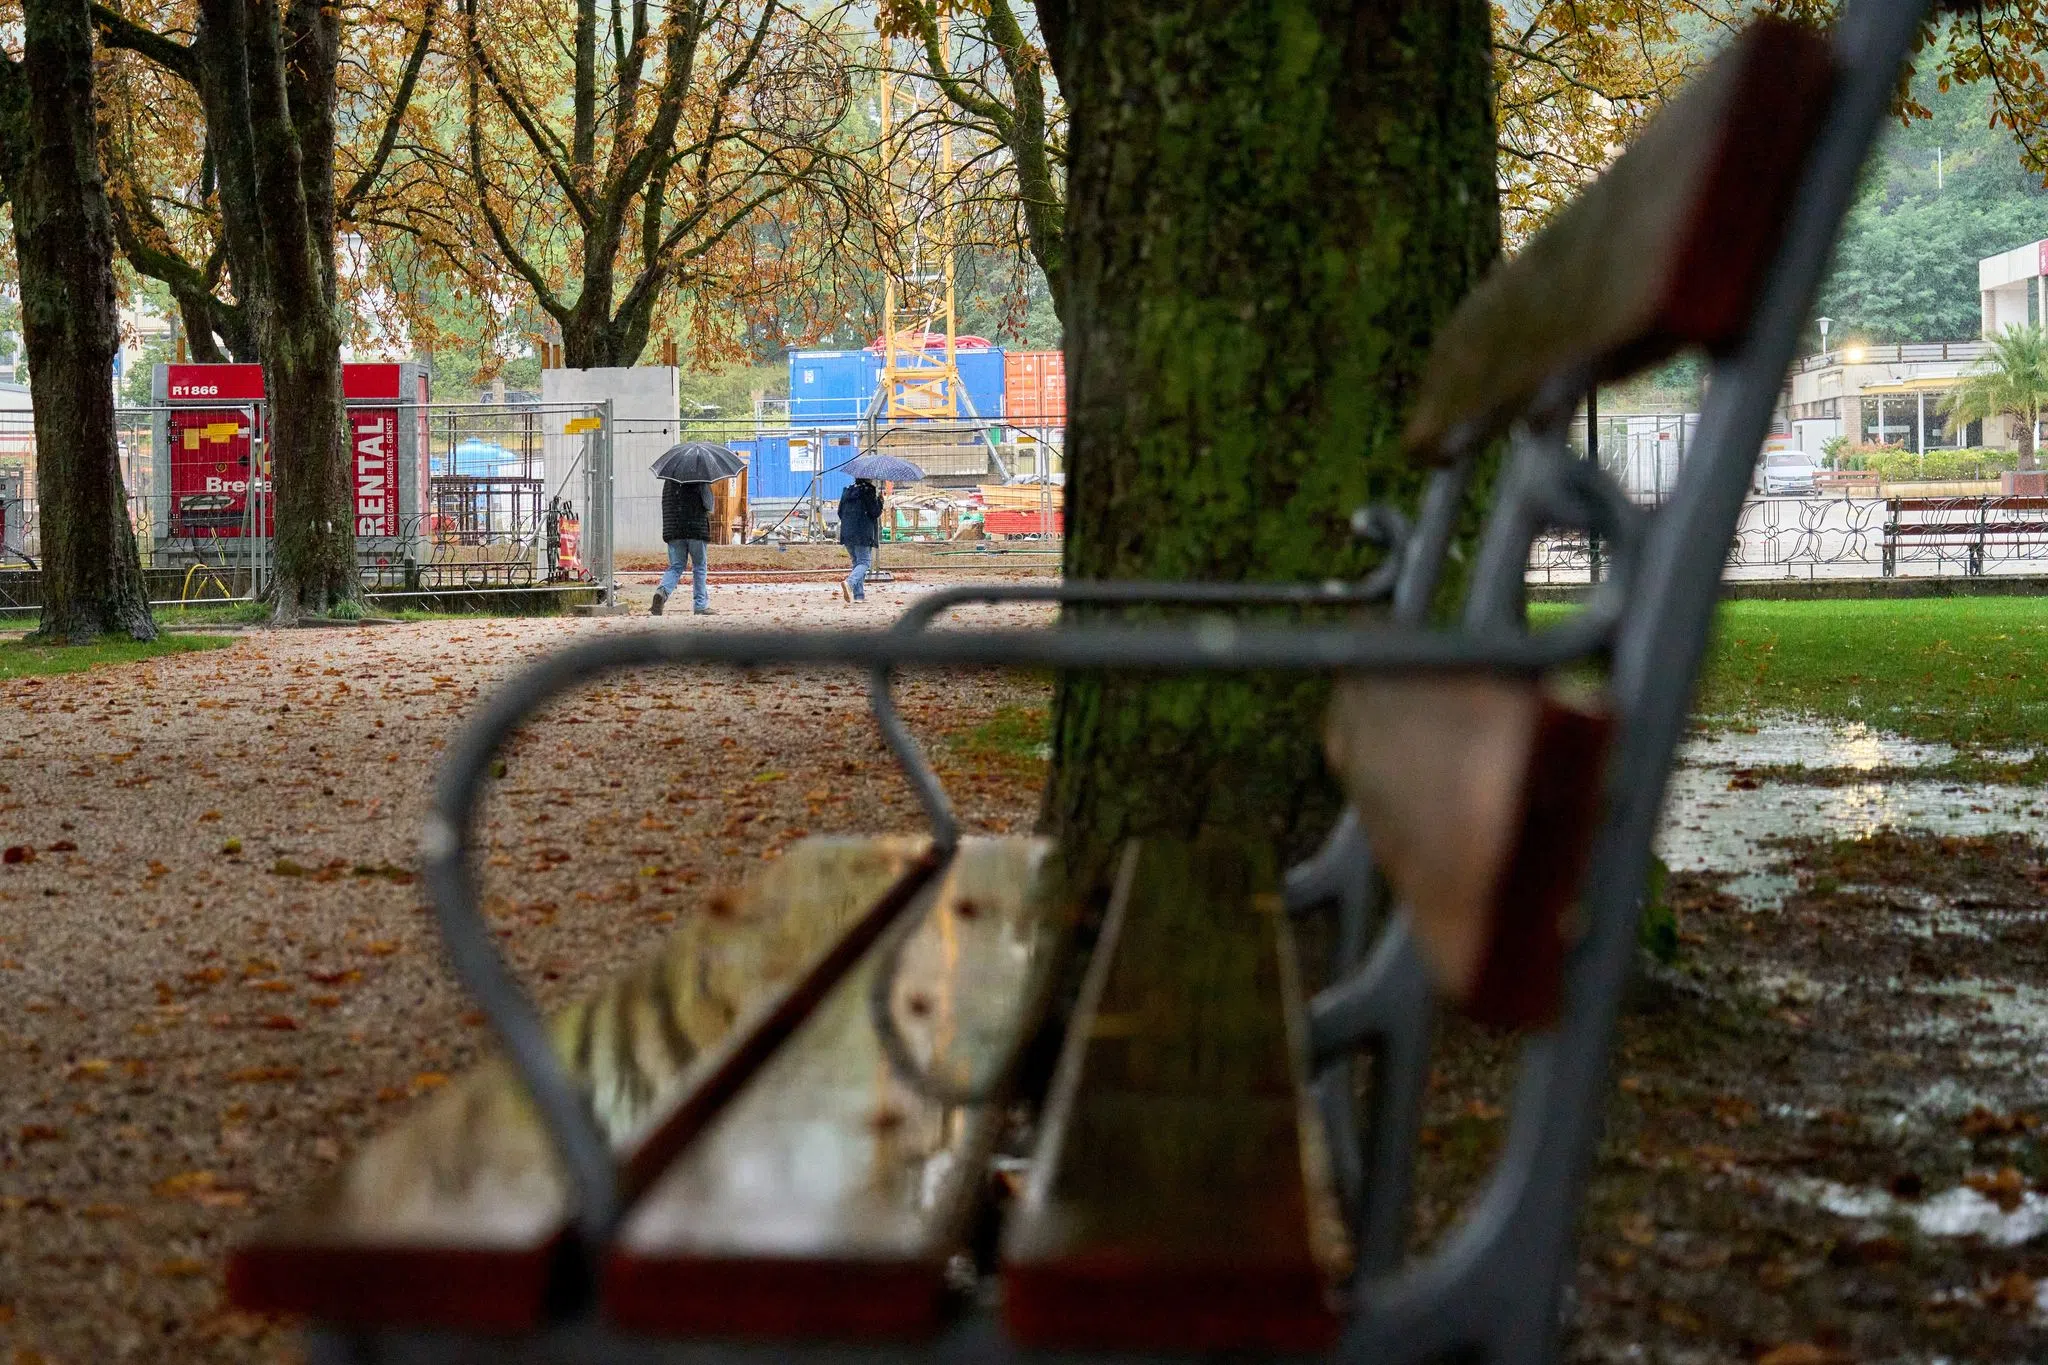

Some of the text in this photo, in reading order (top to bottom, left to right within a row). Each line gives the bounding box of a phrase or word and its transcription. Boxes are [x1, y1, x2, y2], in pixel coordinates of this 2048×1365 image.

[172, 385, 218, 396] R1866
[386, 417, 394, 444] GENSET
[358, 417, 385, 536] RENTAL
[386, 449, 394, 489] AGGREGATE
